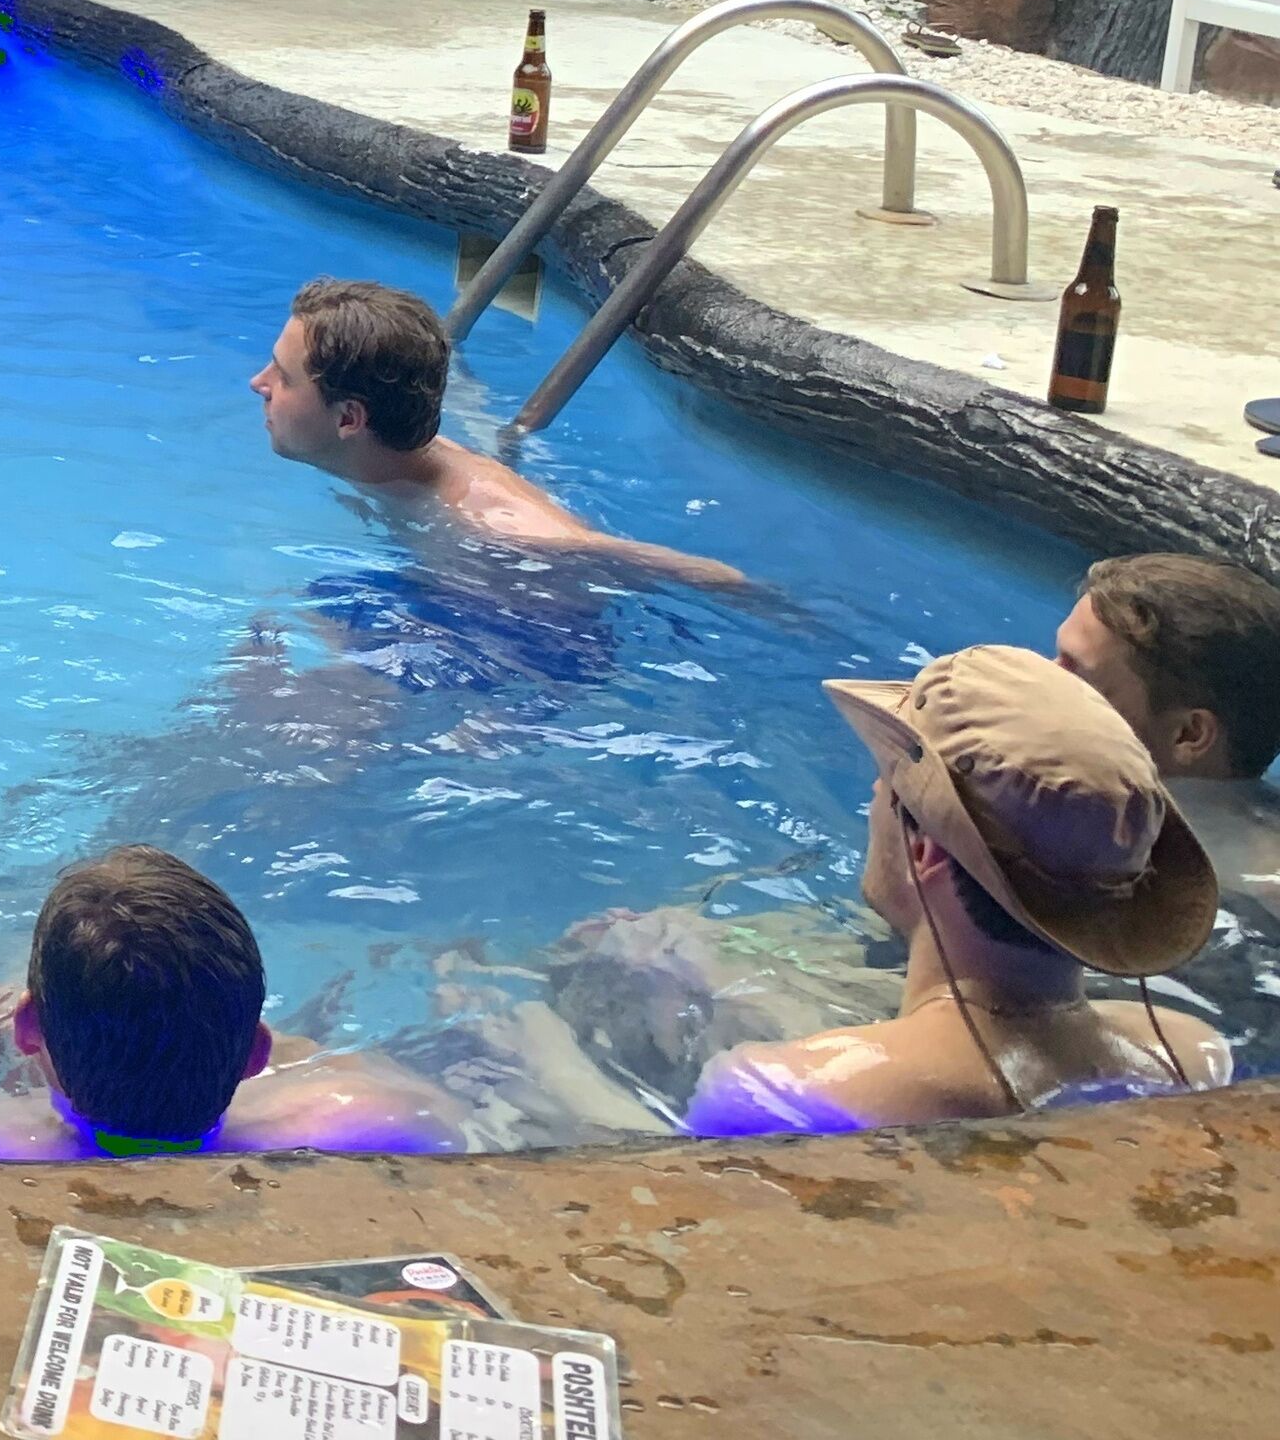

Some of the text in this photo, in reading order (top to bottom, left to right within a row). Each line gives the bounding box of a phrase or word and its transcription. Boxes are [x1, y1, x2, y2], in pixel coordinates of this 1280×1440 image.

[31, 1245, 93, 1429] NOT VALID FOR WELCOME DRINK
